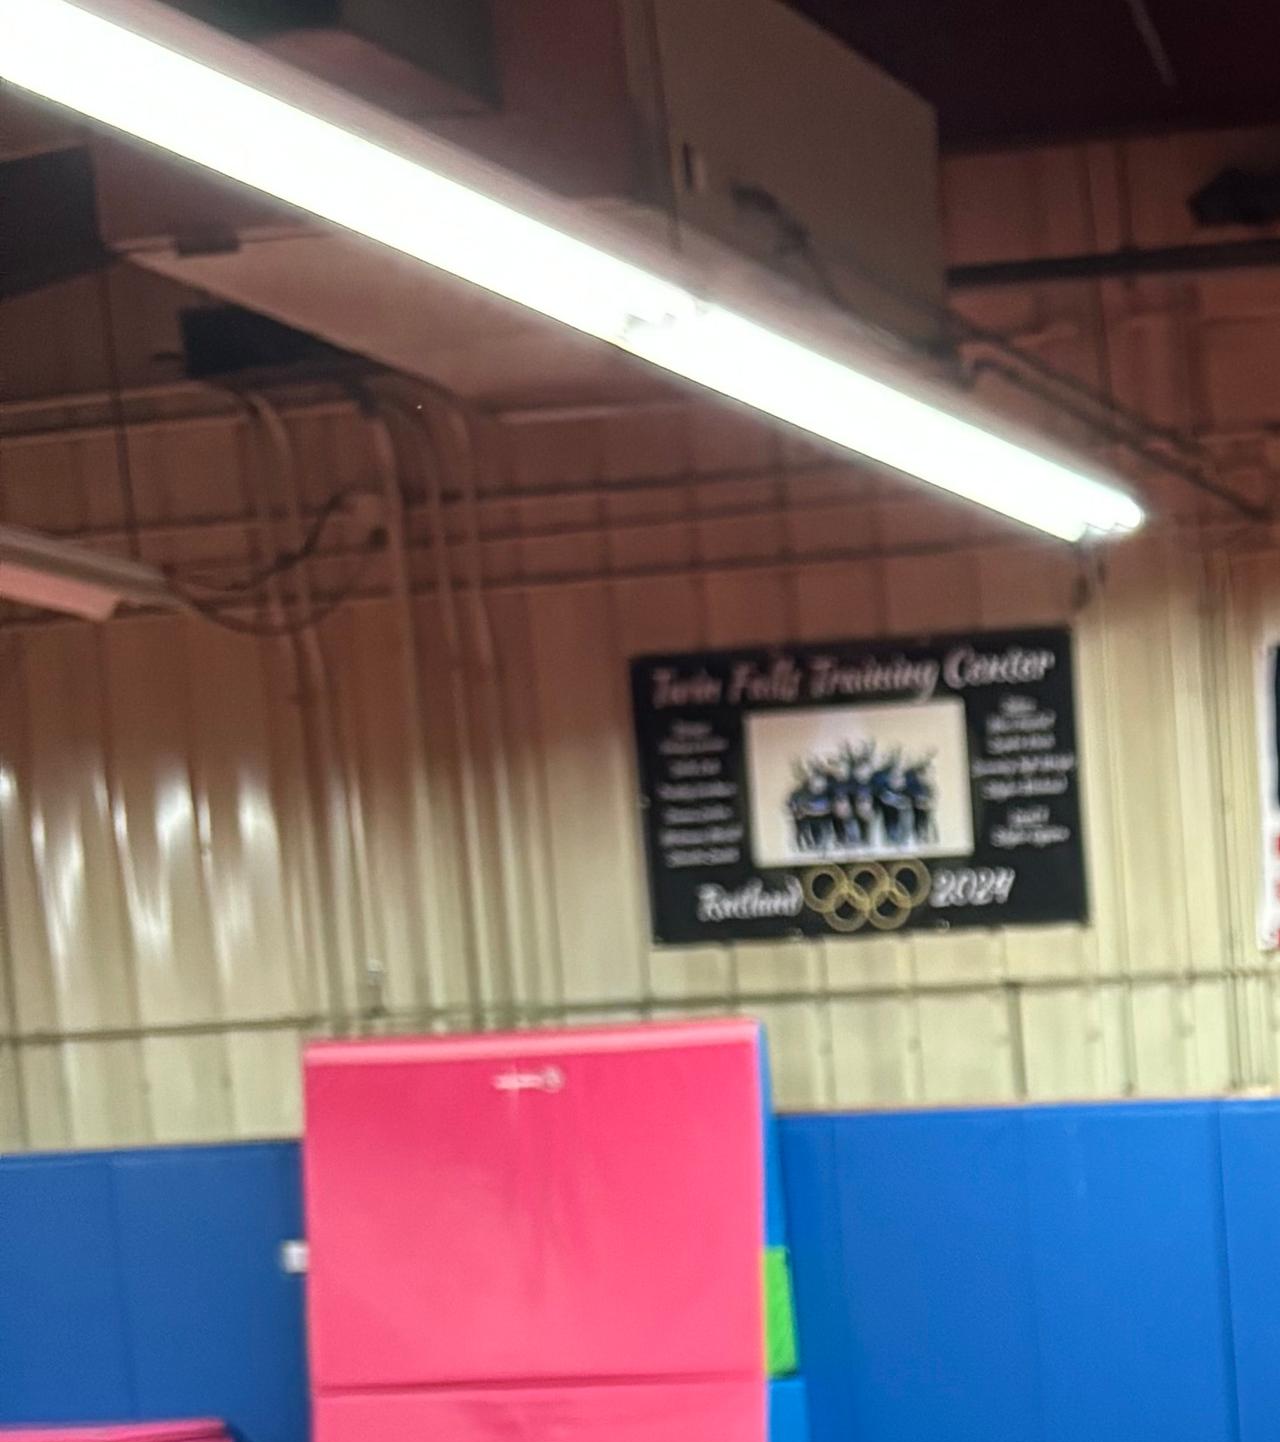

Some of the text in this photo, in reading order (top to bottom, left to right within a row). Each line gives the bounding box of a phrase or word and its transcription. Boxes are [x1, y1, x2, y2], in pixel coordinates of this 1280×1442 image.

[652, 644, 1055, 708] Twin Falls Training Center
[931, 865, 1016, 908] 2024
